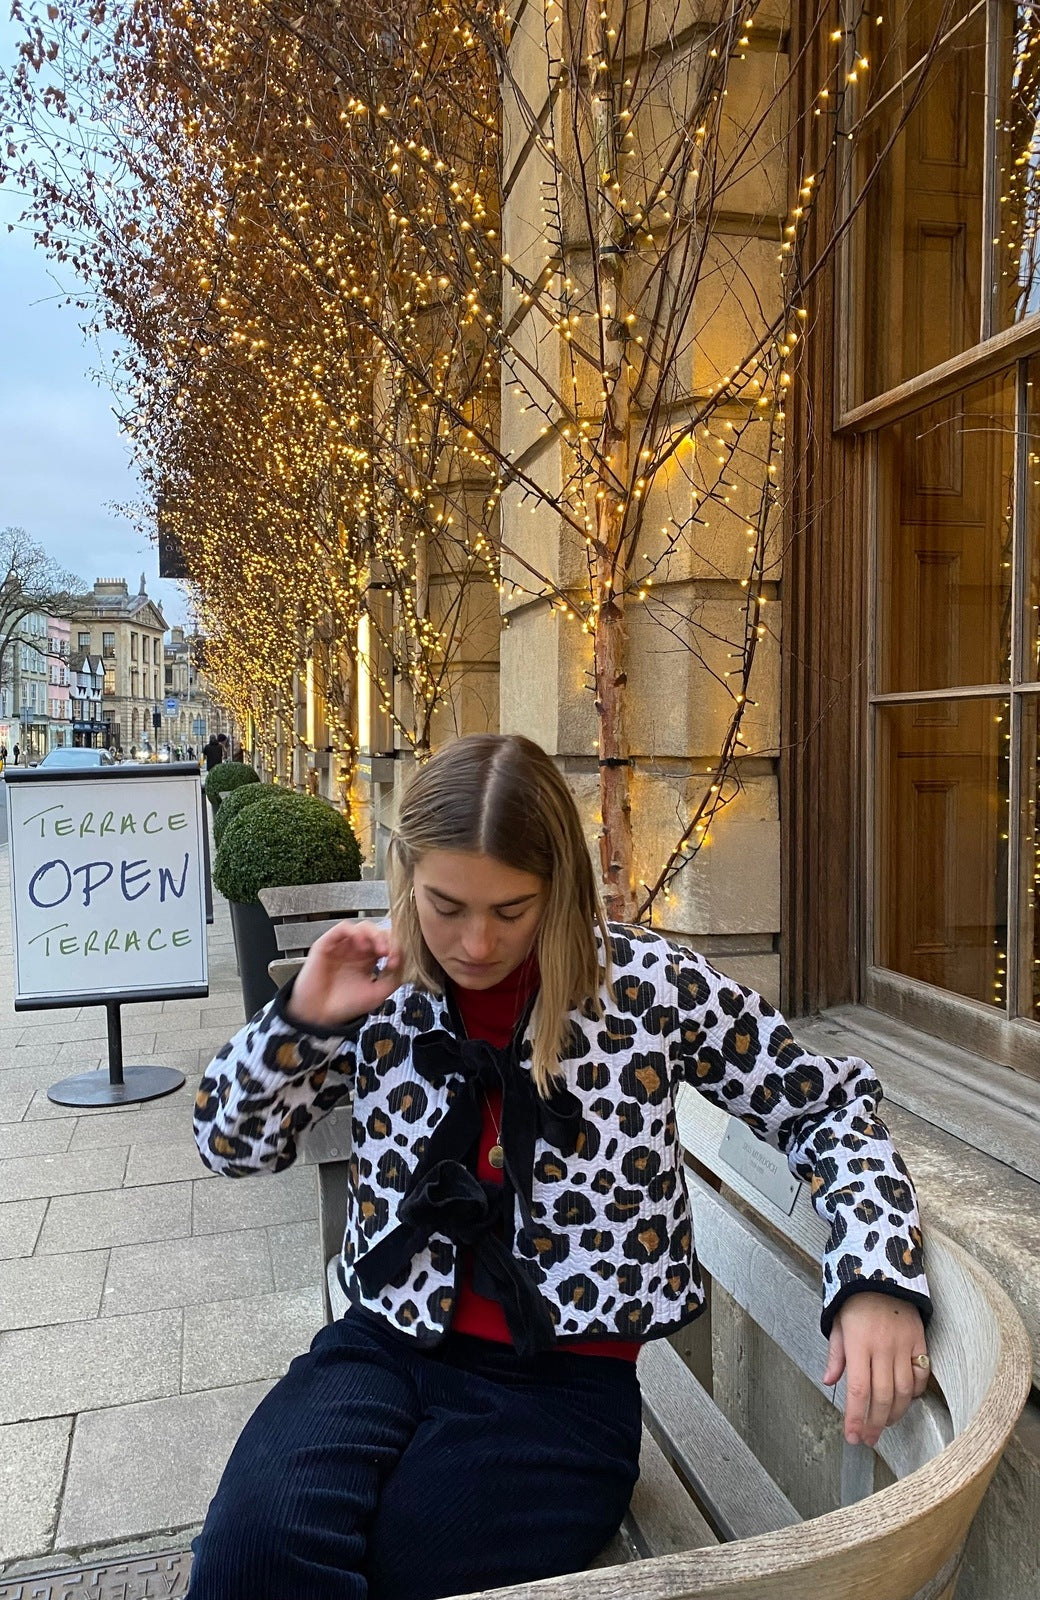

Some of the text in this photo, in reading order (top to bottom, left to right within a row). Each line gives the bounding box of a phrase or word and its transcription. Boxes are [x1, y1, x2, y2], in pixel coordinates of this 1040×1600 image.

[23, 804, 189, 838] TERRACE
[28, 852, 190, 909] OPEN
[28, 923, 193, 957] TERRACE
